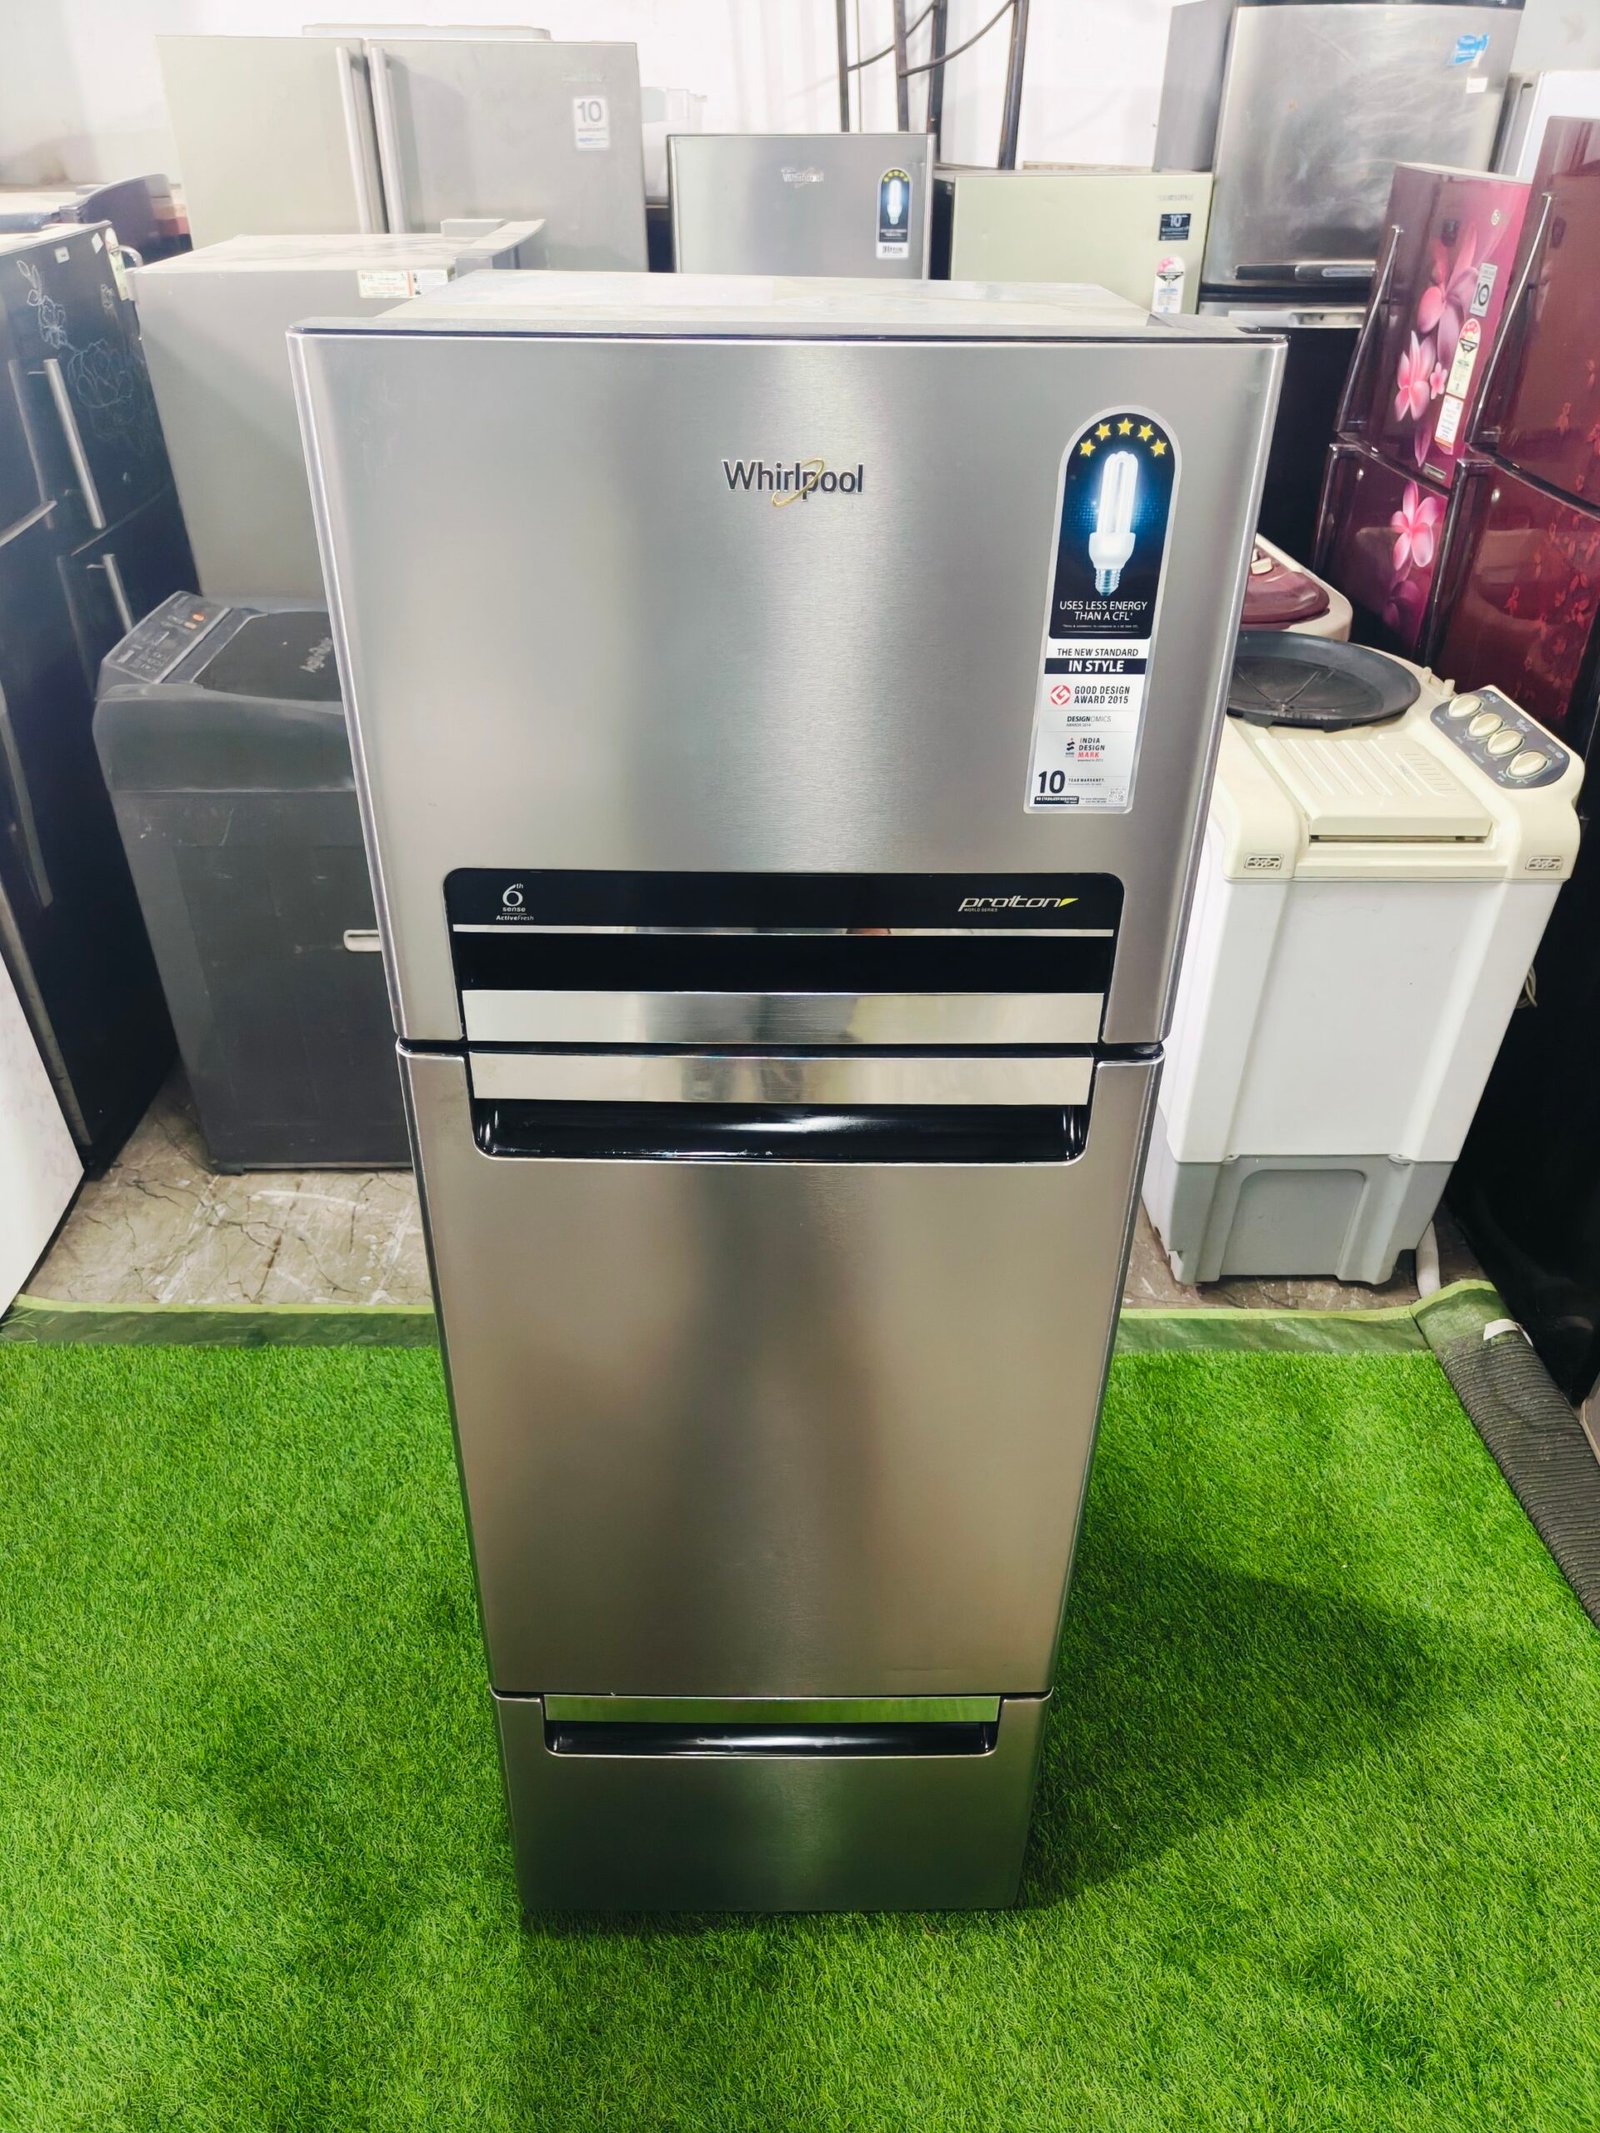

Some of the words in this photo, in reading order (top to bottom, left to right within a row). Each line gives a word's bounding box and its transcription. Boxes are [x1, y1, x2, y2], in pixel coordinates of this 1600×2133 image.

[577, 101, 602, 122] 10
[1170, 215, 1182, 227] 10
[721, 459, 864, 502] Whirlpool
[1059, 600, 1083, 610] USES
[1085, 601, 1107, 610] LESS
[1109, 601, 1148, 611] ENERGY
[1074, 611, 1101, 620] THAN
[1103, 611, 1110, 620] A
[1057, 648, 1072, 656] THE
[1074, 648, 1093, 656] NEW
[1095, 648, 1139, 656] STANDARD
[1068, 660, 1082, 672] IN
[1085, 660, 1125, 672] STYLE
[1074, 686, 1097, 694] GOOD
[1100, 686, 1130, 694] DESIGN
[1074, 695, 1105, 704] AWARD
[1108, 695, 1129, 704] 2015
[1038, 770, 1066, 794] 10
